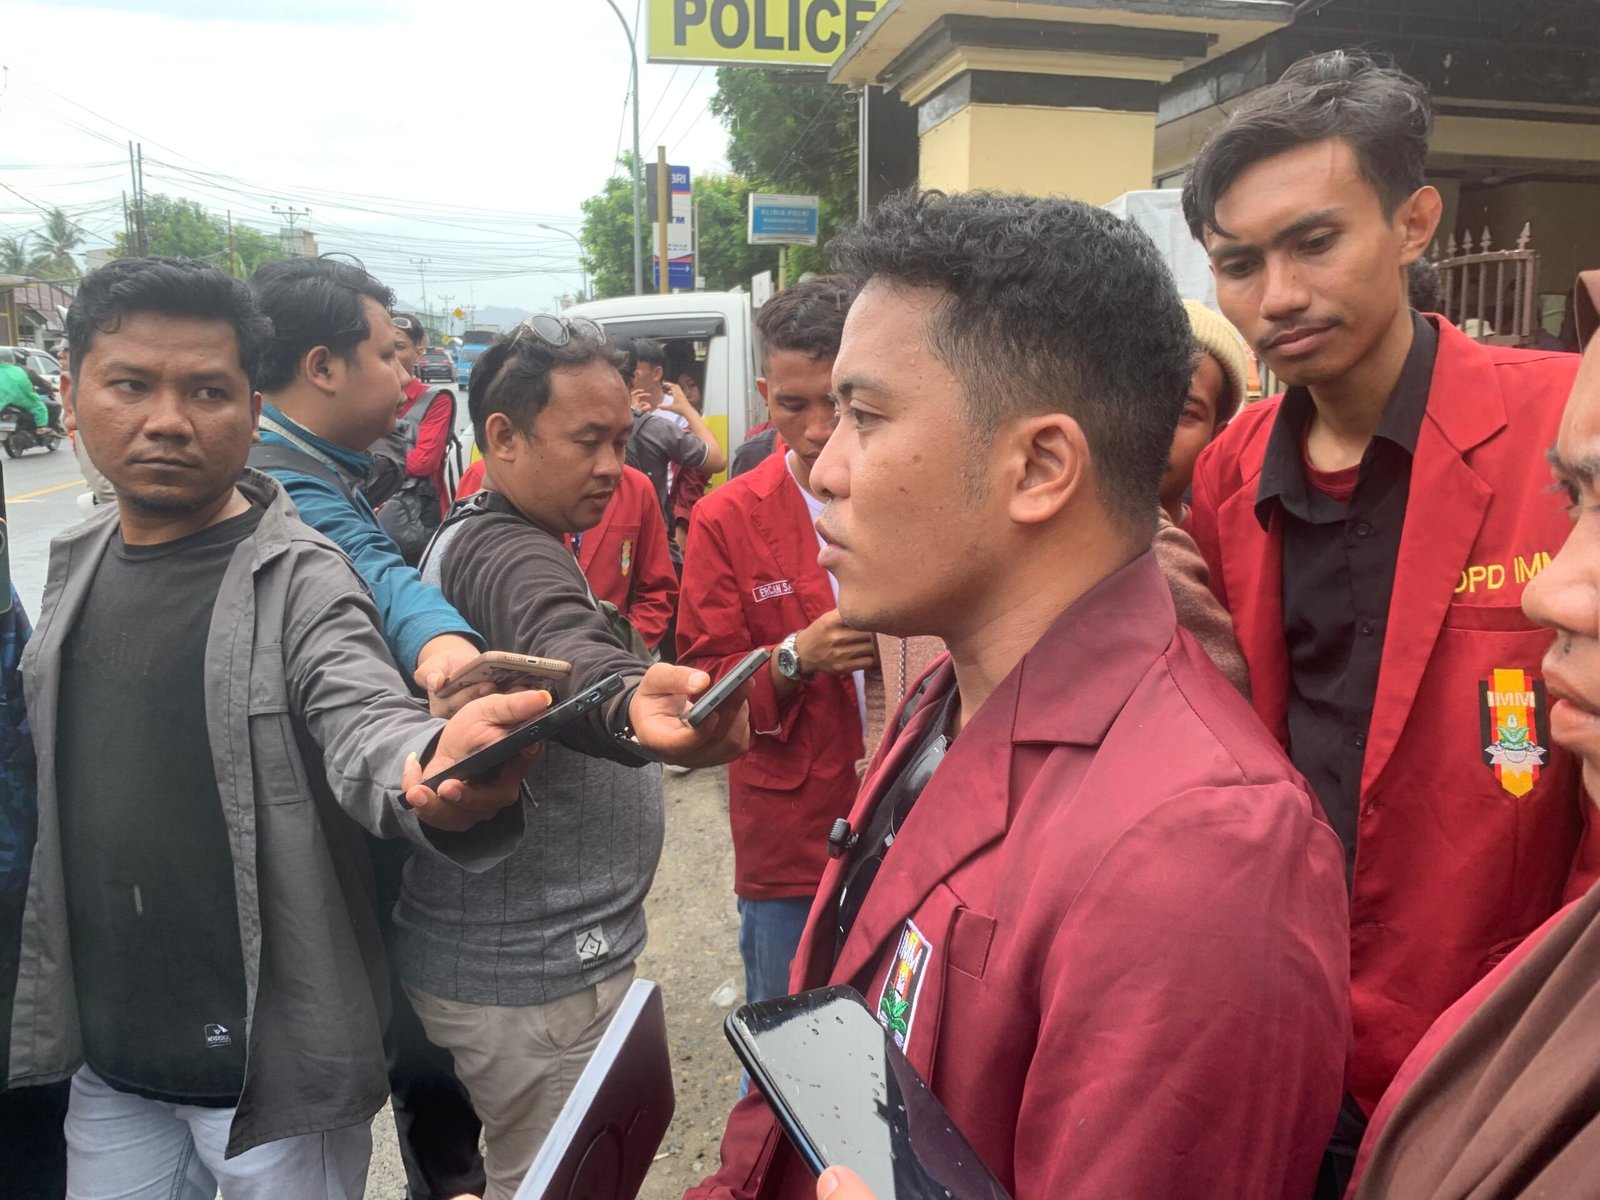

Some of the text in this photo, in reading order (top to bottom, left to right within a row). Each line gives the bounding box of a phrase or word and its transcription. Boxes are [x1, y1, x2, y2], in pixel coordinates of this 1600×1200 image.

[674, 0, 877, 54] POLICE
[759, 584, 781, 597] ERCAN
[1487, 691, 1536, 707] IMM
